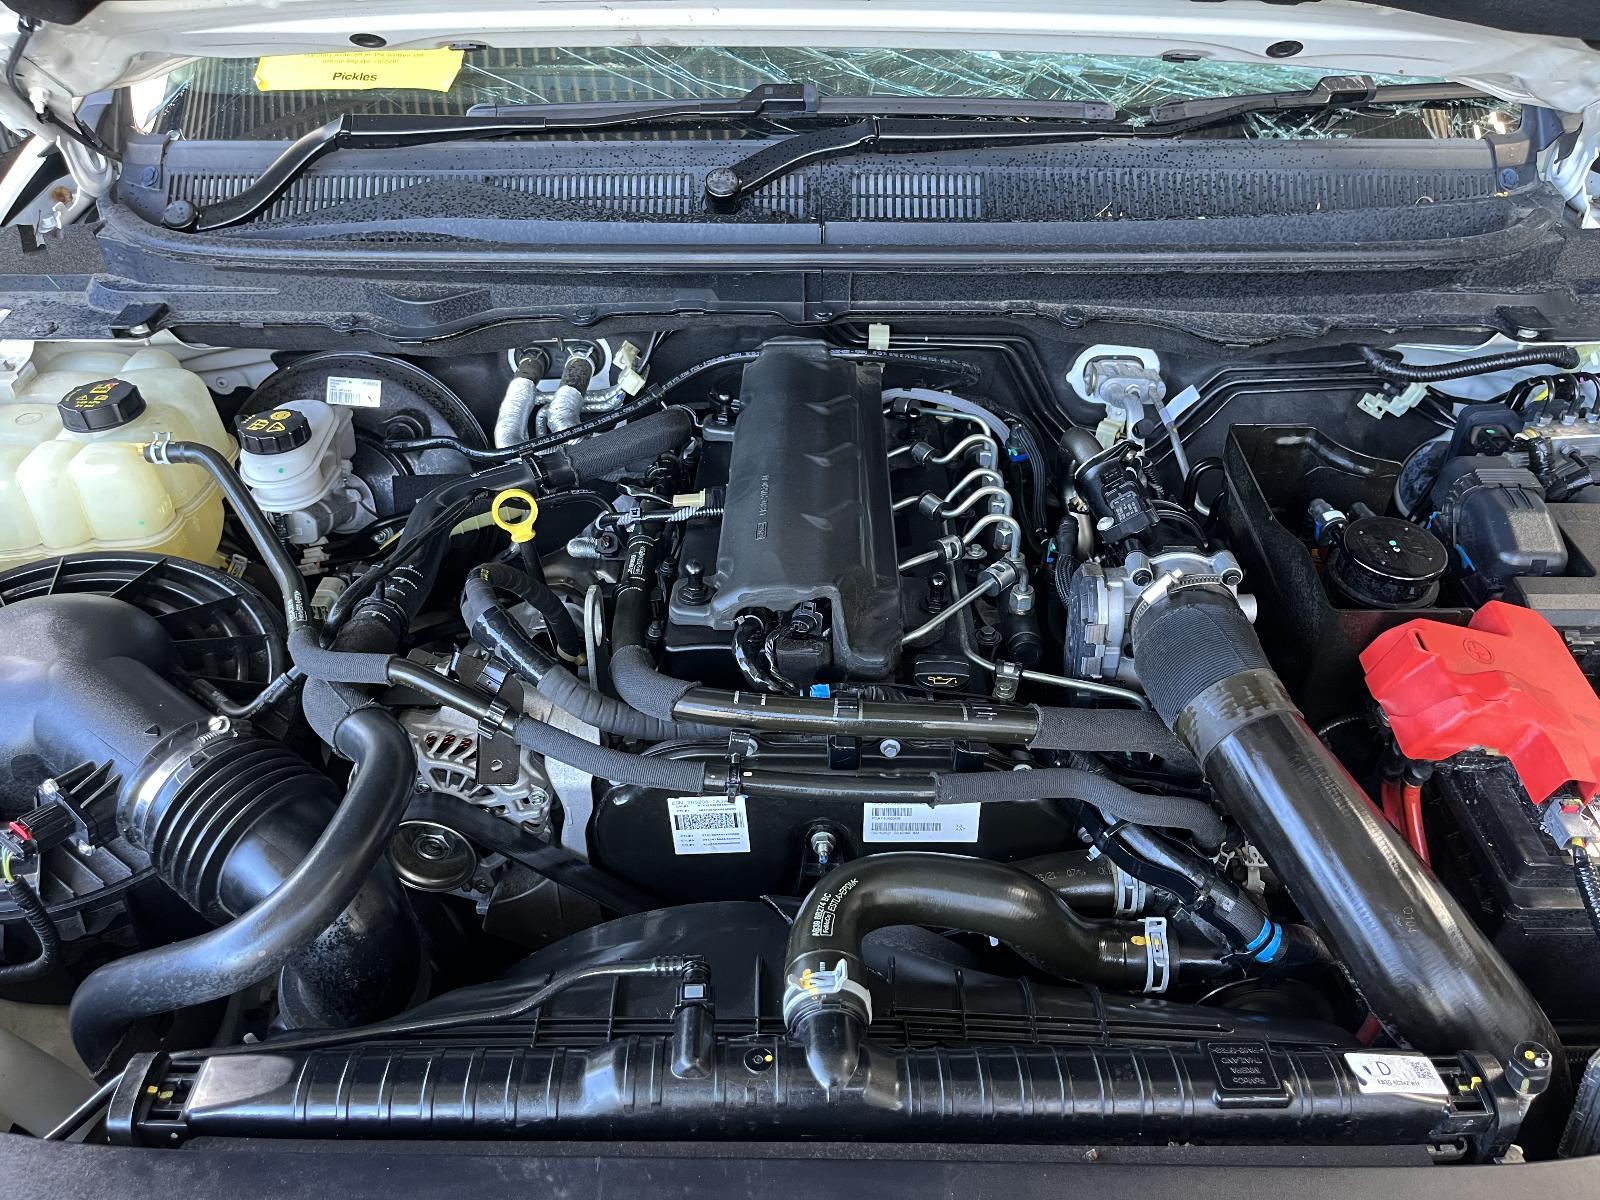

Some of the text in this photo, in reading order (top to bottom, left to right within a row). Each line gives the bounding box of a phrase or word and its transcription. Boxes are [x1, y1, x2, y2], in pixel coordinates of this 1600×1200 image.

[332, 71, 378, 82] Pickles
[820, 892, 832, 902] BC
[822, 913, 832, 934] FoMoCo
[1220, 1056, 1263, 1065] THAILAND
[1375, 1060, 1392, 1076] D
[1231, 1076, 1267, 1085] FoMoCo
